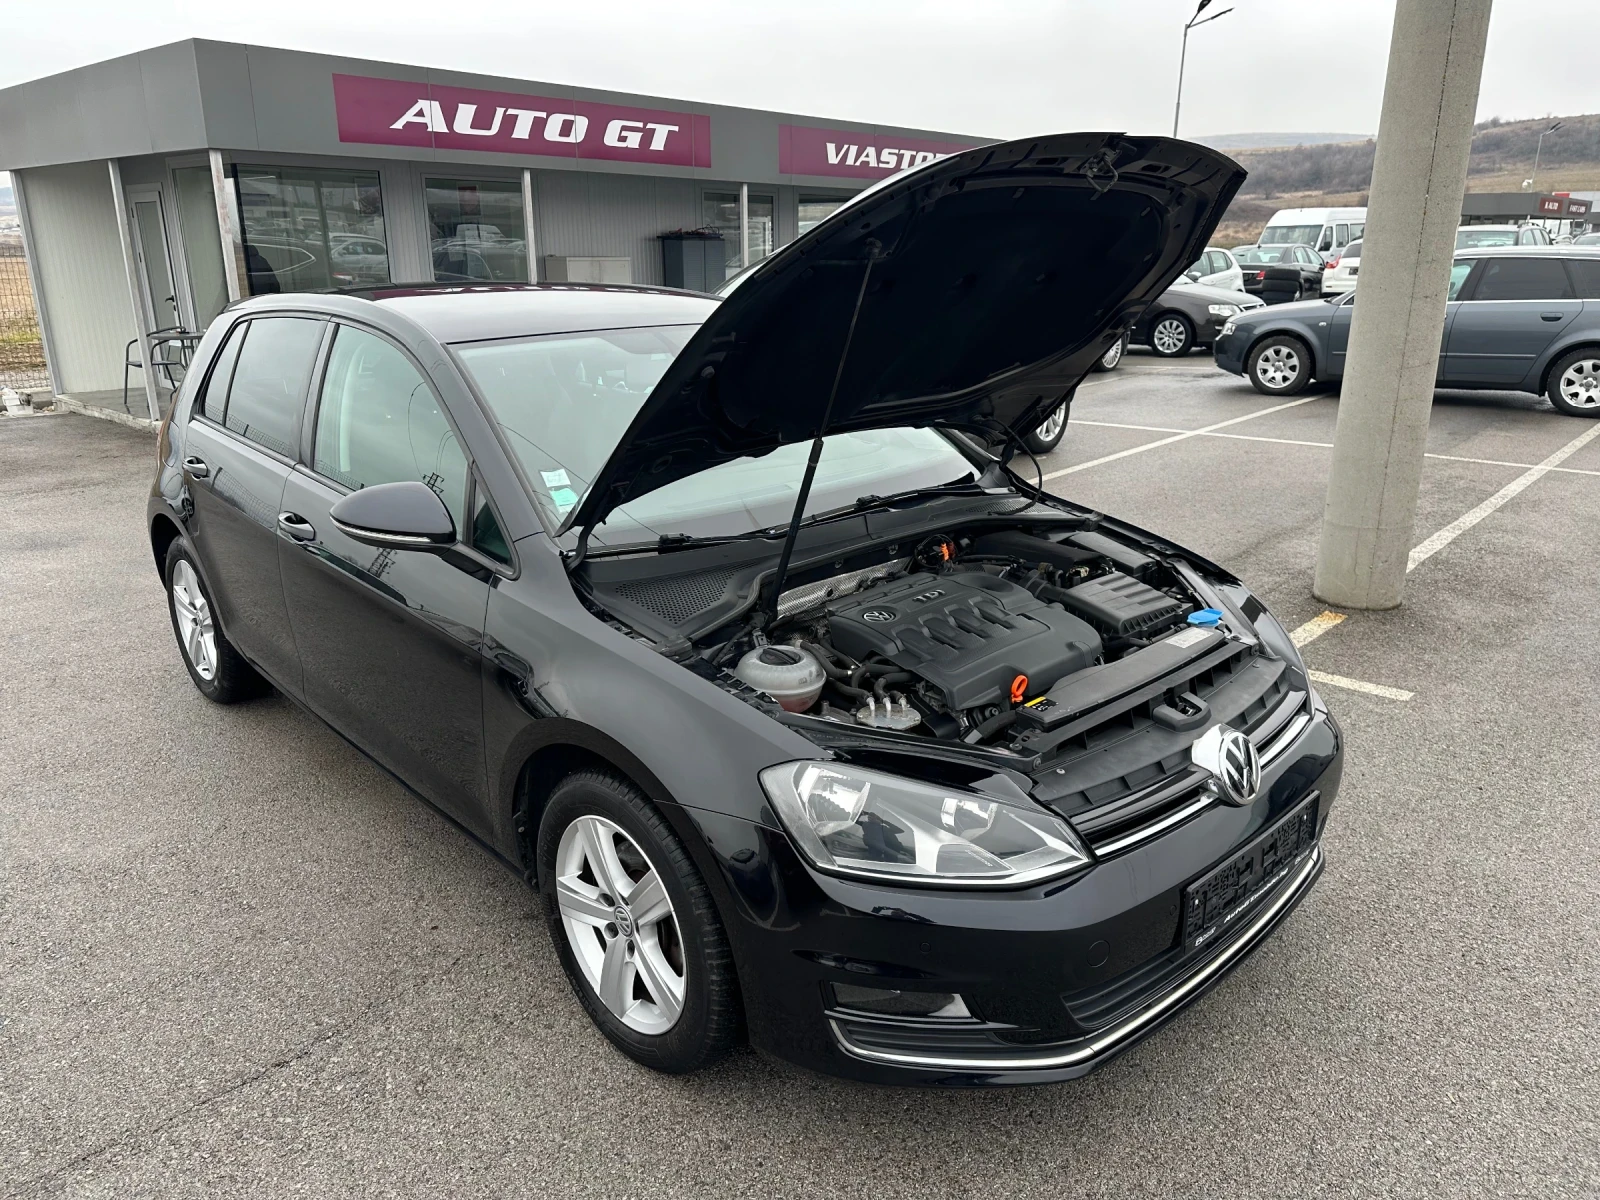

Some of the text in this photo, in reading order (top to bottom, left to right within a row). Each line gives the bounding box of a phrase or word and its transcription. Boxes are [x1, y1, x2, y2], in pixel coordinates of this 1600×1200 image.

[389, 98, 679, 151] AUTO GT
[825, 142, 950, 169] VIASTO
[912, 589, 946, 603] TDI
